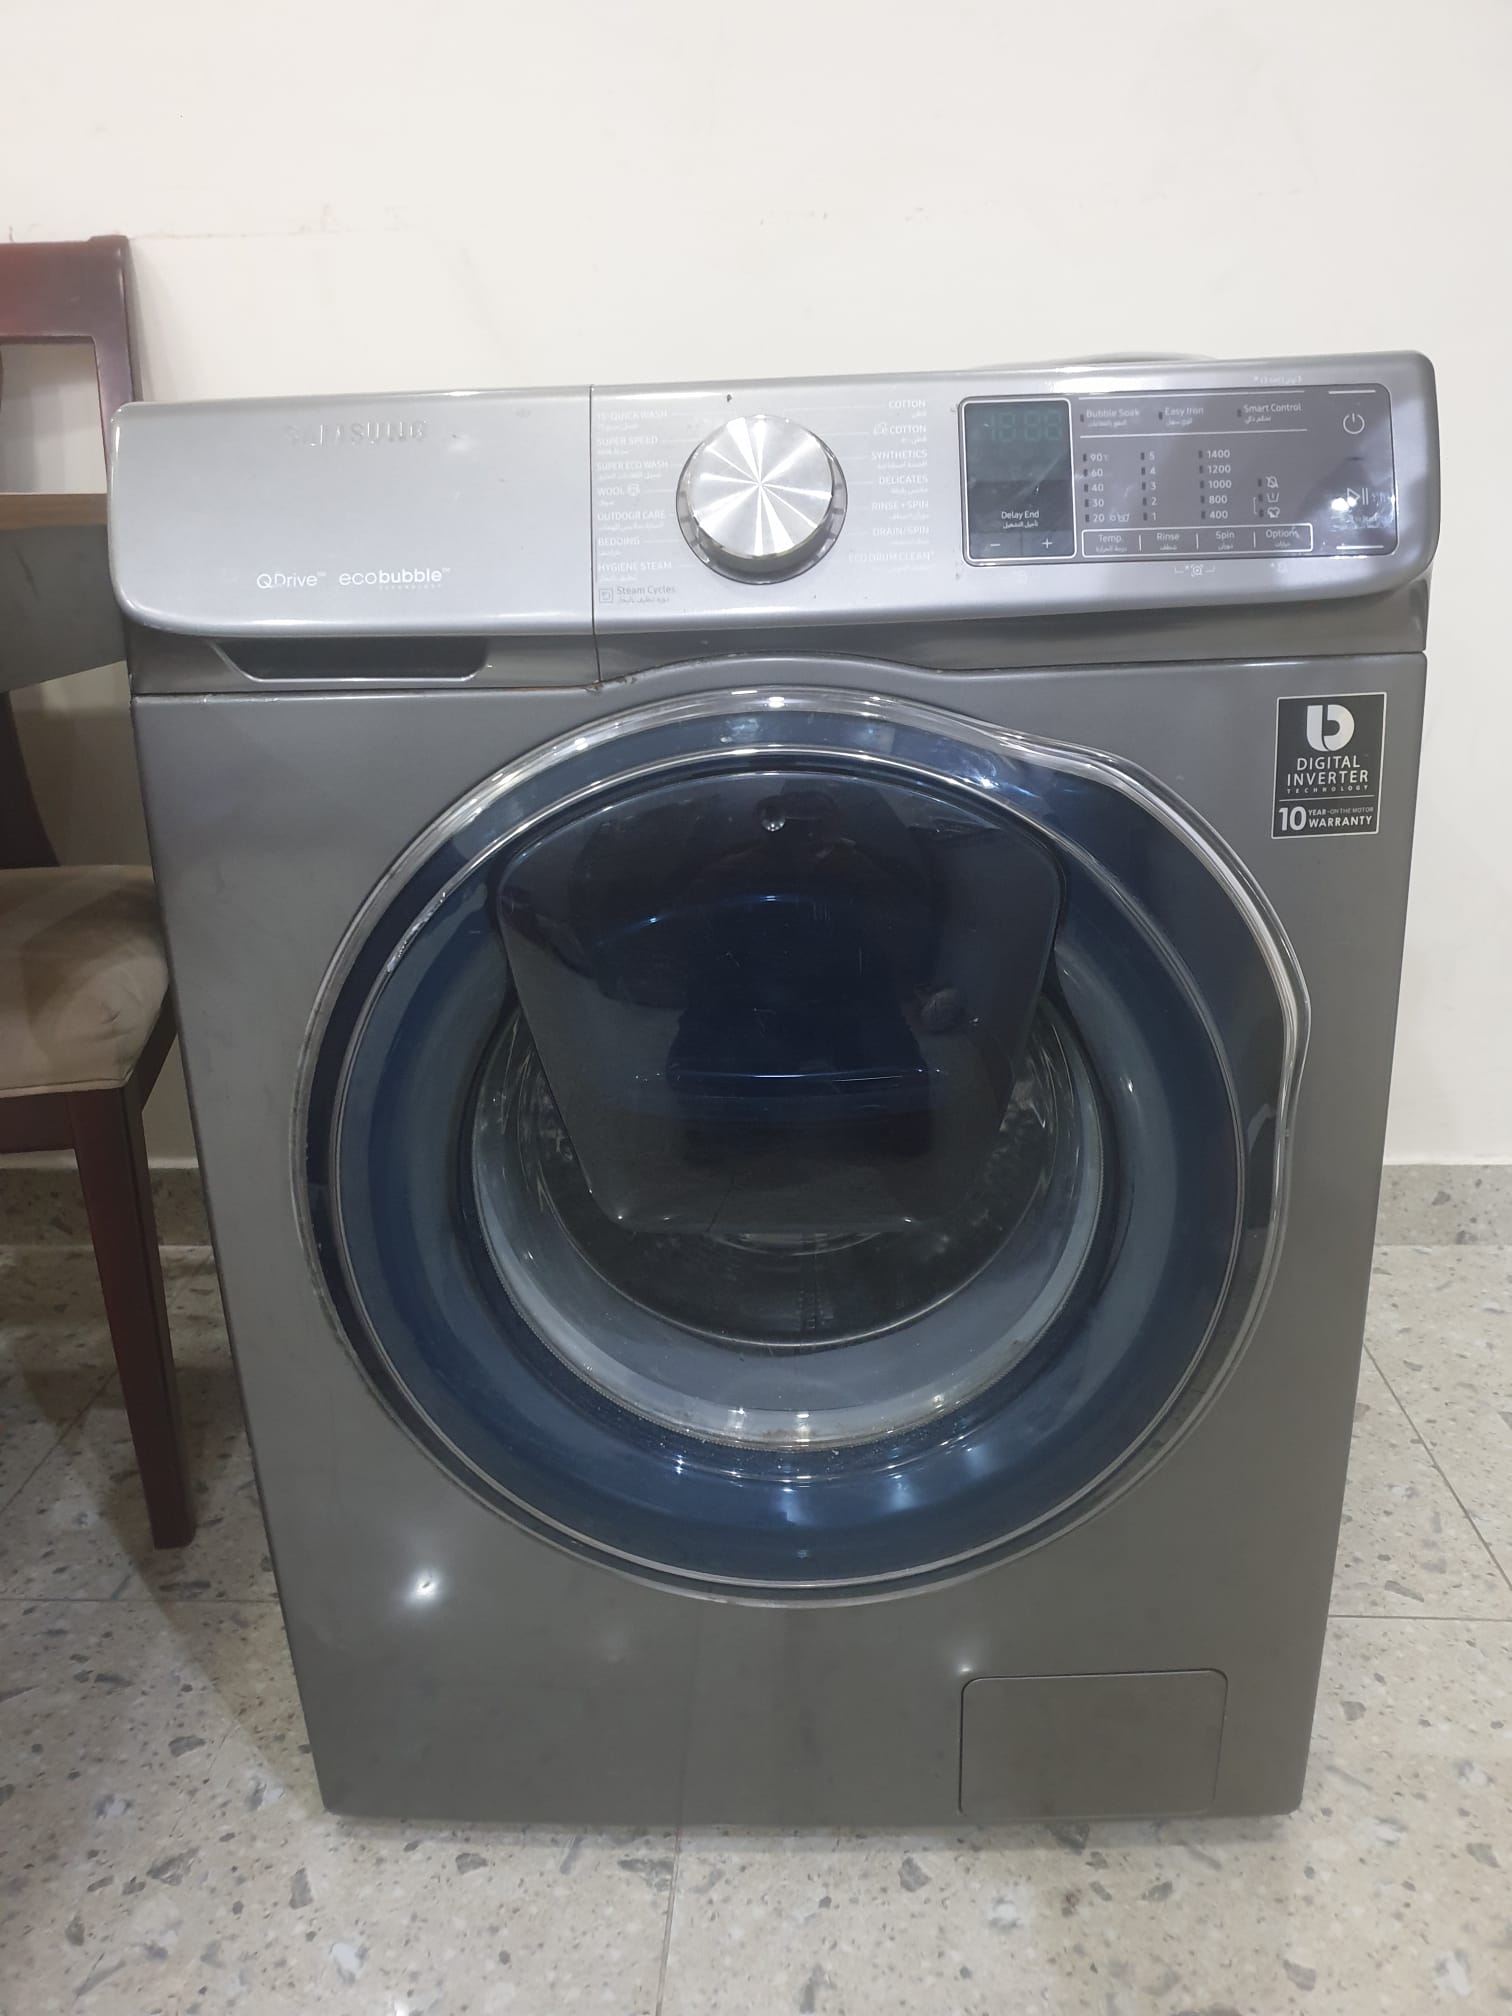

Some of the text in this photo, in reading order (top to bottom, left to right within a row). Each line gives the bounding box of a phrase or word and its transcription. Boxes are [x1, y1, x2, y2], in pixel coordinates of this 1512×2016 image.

[888, 399, 926, 409] COTTON
[1243, 402, 1302, 413] Smart Control
[1086, 407, 1140, 418] Bubble Soak
[1164, 406, 1204, 416] Easy Iron
[889, 423, 927, 434] COTTON
[871, 449, 928, 461] SYNTHETICS
[1149, 451, 1155, 461] 5
[1207, 449, 1231, 459] 1400
[1091, 468, 1104, 477] 60
[1149, 466, 1156, 475] 4
[1208, 464, 1231, 474] 1200
[879, 475, 928, 485] DELICATES
[1208, 479, 1232, 489] 1000
[1091, 483, 1104, 492] 40
[1150, 481, 1156, 491] 3
[597, 486, 625, 497] WOOL
[1092, 498, 1105, 508] 30
[1151, 496, 1158, 506] 2
[1208, 495, 1228, 504] 800
[871, 501, 899, 511] RINSE
[907, 499, 929, 509] SPIN
[597, 509, 666, 521] OUTDOOR CARE
[1001, 509, 1040, 520] Delay End
[1093, 513, 1105, 523] 20
[1152, 512, 1157, 521] 1
[1209, 510, 1229, 519] 400
[1156, 532, 1180, 541] Rinse
[1215, 530, 1235, 540] Spin
[1265, 527, 1300, 539] Options
[598, 537, 641, 546] BEDDING
[598, 561, 673, 572] HYGIENE STEAM
[616, 584, 677, 596] Steam Cycles
[1296, 755, 1361, 771] DIGITAL
[1287, 769, 1369, 787] INVERTER
[1286, 784, 1369, 794] TECHNOLOGY
[1352, 806, 1374, 814] MOTOR
[1278, 806, 1308, 831] 10
[1308, 815, 1373, 829] WARRANTY
